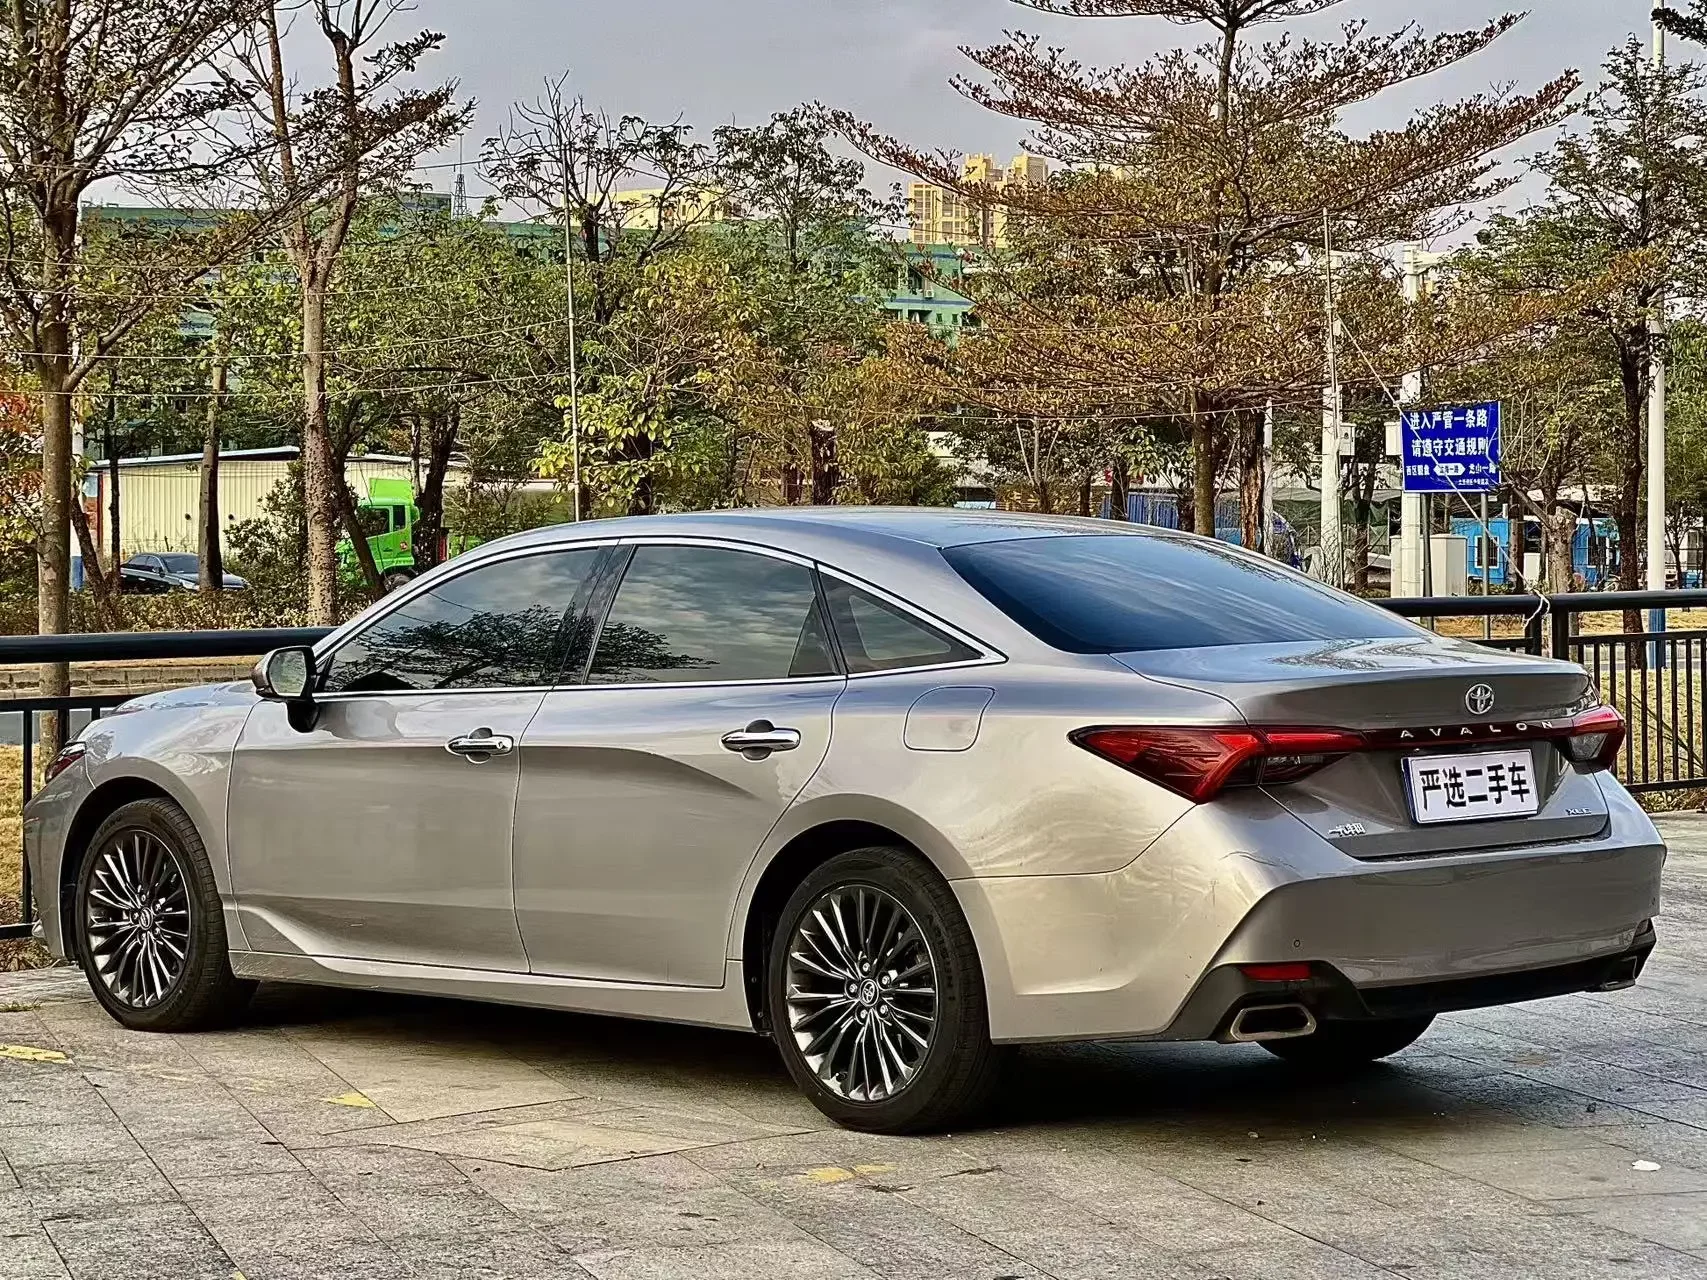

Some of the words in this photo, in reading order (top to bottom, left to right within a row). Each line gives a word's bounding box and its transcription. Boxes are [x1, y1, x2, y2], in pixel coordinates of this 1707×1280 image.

[1410, 408, 1488, 430] 进入严管一条路
[1411, 437, 1488, 457] 请遵守交通规则
[1400, 720, 1553, 739] AVALON
[1418, 761, 1531, 811] 严选二手车
